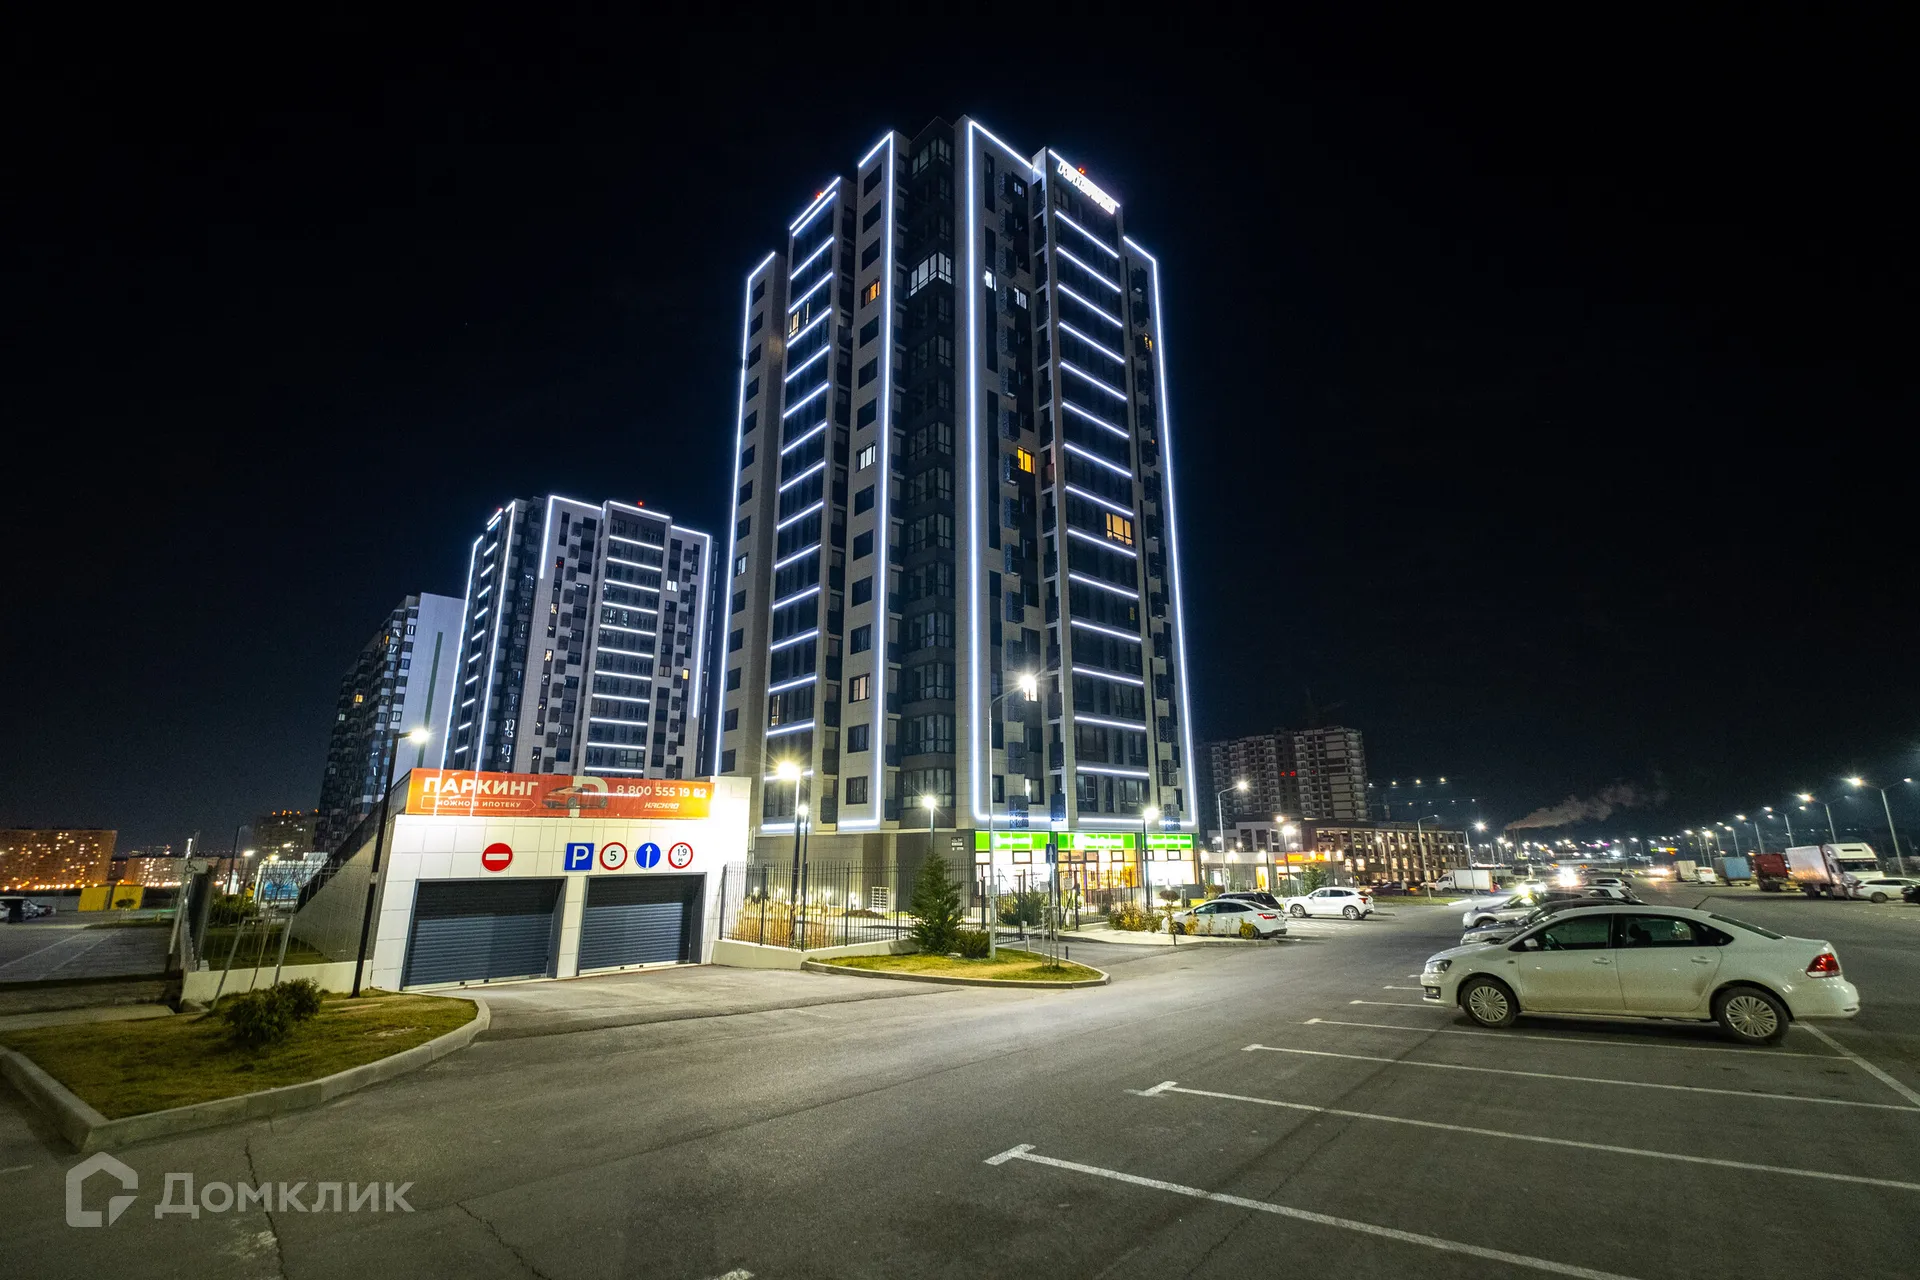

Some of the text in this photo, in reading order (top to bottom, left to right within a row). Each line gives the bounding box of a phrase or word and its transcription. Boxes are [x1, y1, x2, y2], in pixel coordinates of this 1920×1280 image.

[423, 777, 539, 796] ПАРКИНГ
[616, 785, 625, 796] 8
[628, 785, 651, 796] 800
[655, 786, 676, 797] 555
[679, 787, 690, 797] 19
[609, 850, 617, 861] 5
